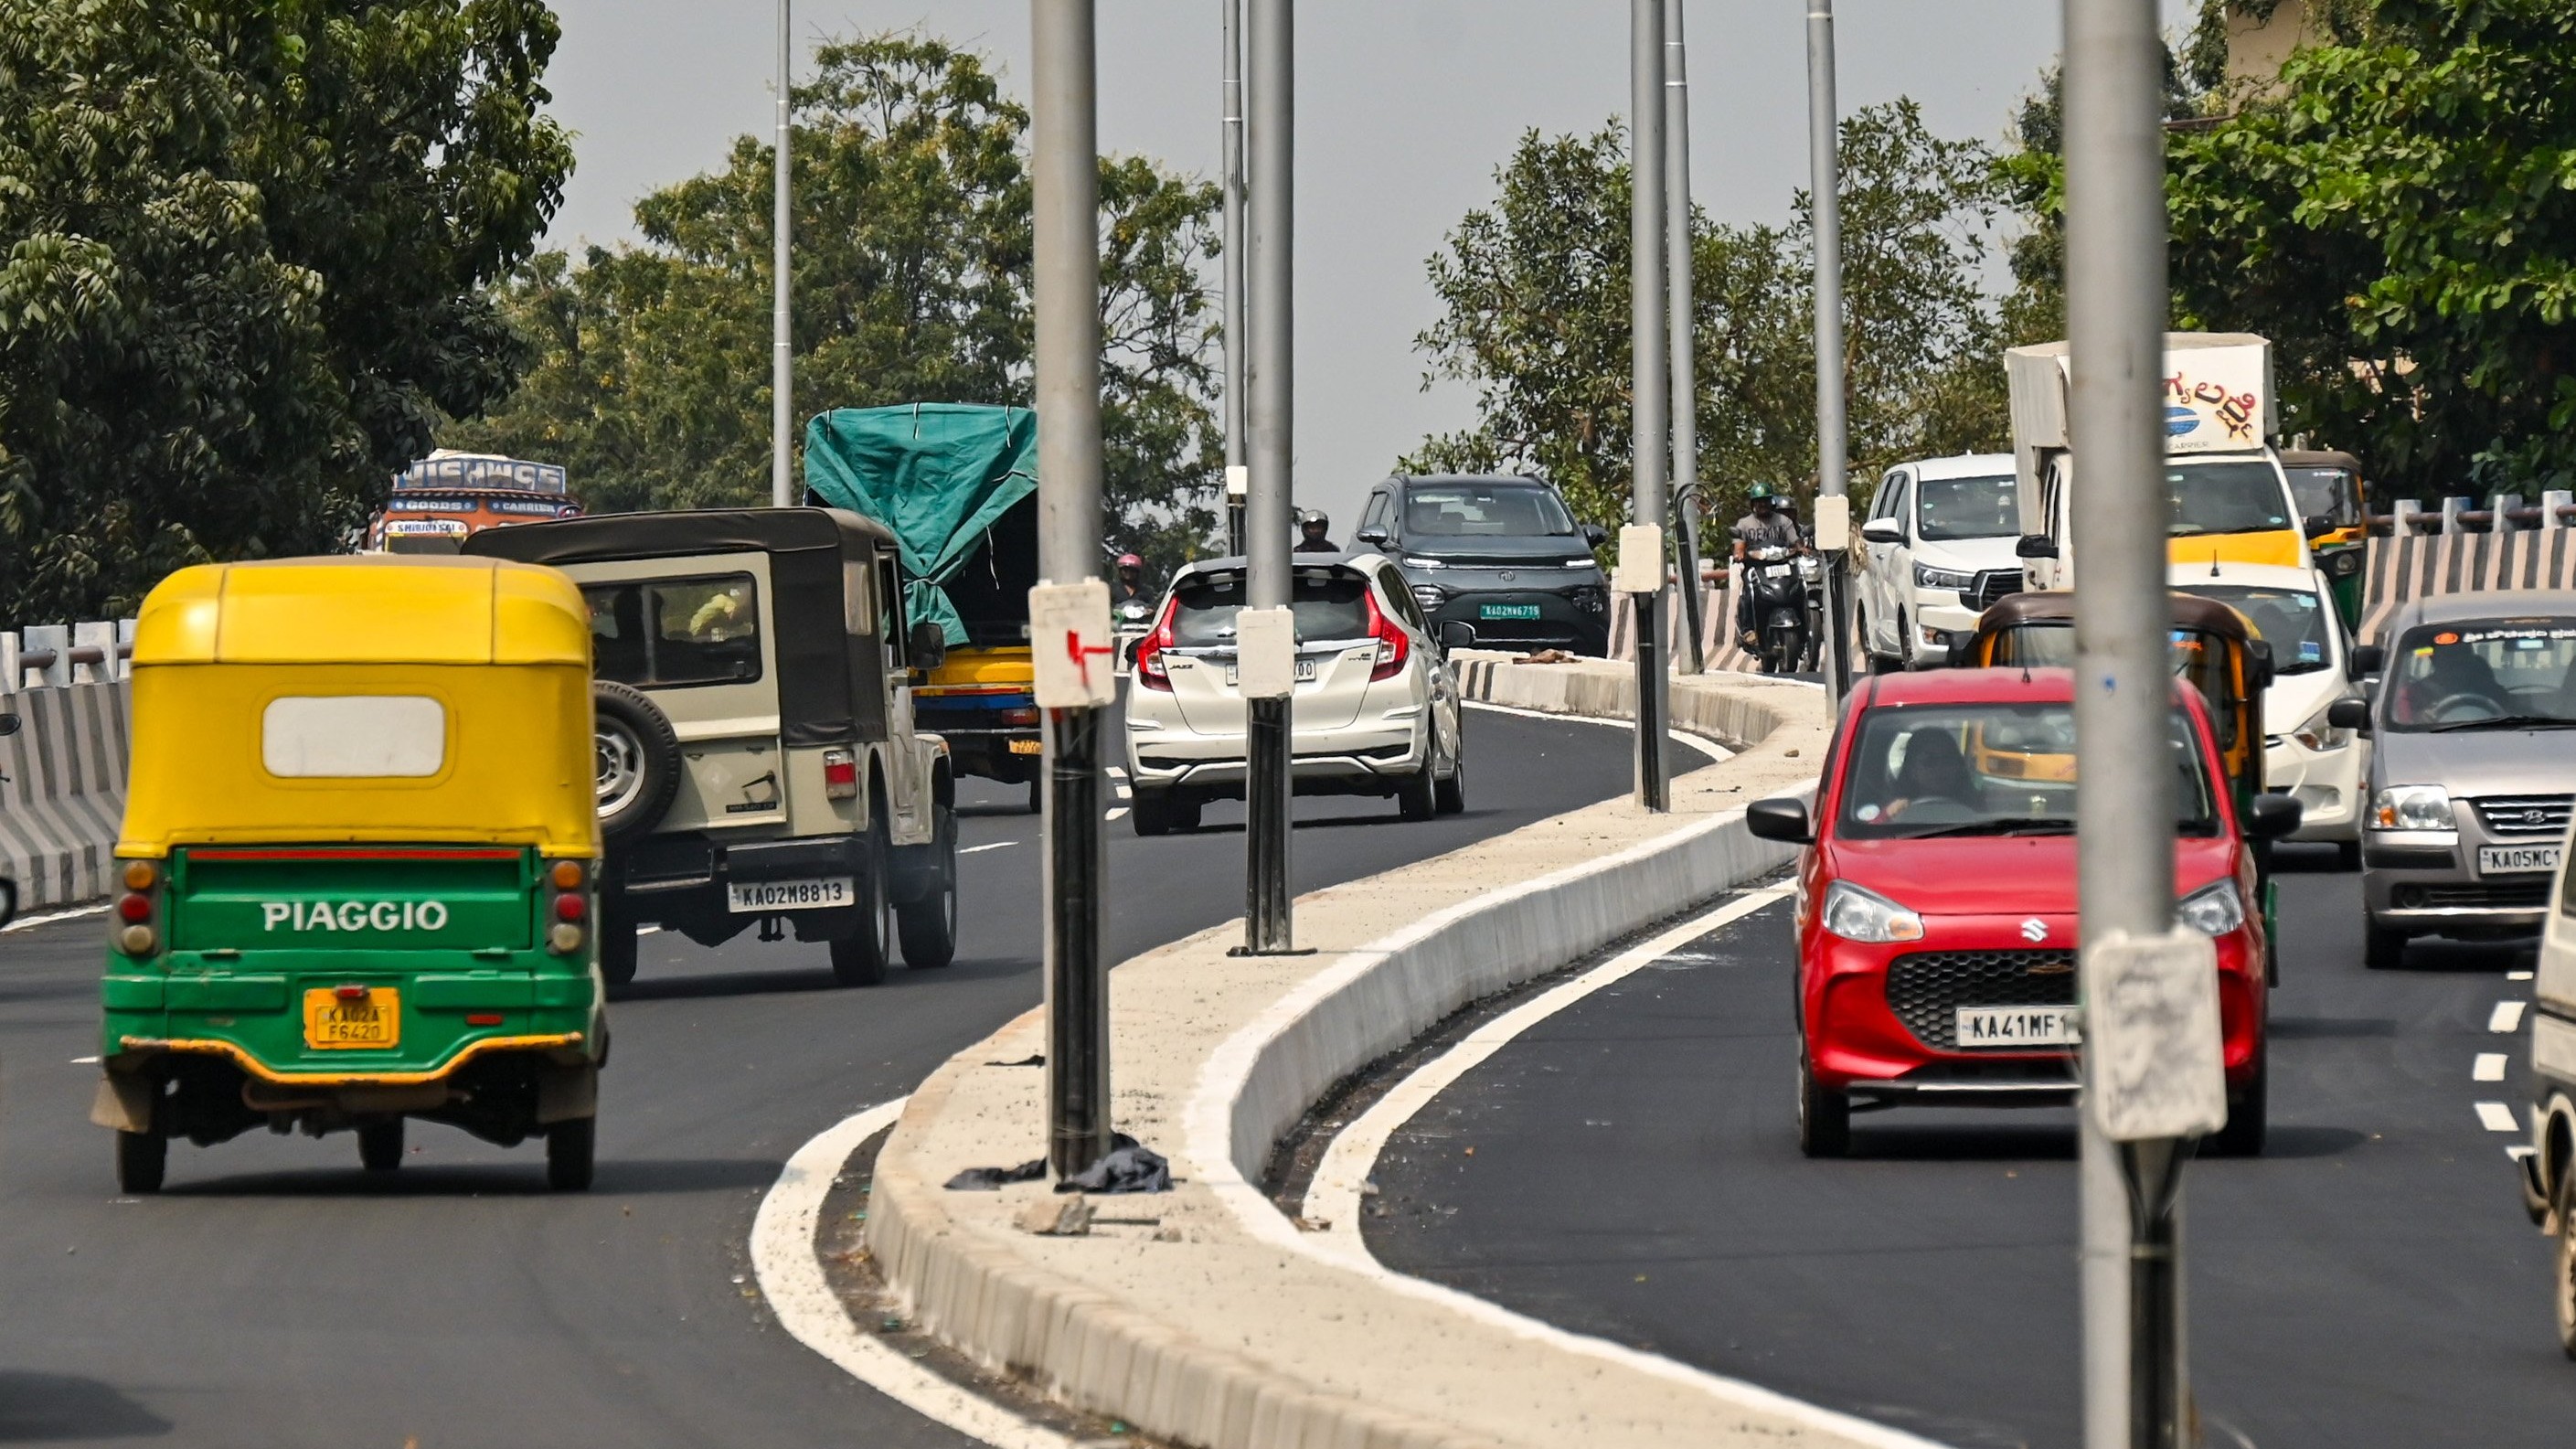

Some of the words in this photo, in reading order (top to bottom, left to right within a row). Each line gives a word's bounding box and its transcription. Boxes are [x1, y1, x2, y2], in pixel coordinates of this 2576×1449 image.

[406, 500, 463, 510] GOODS
[503, 502, 556, 513] CARRIER
[743, 882, 842, 906] KA02M8813
[261, 901, 448, 932] PIAGGIO
[329, 1008, 379, 1023] KA02A
[329, 1025, 380, 1039] F6420
[1974, 1015, 2068, 1038] KA41MF1
